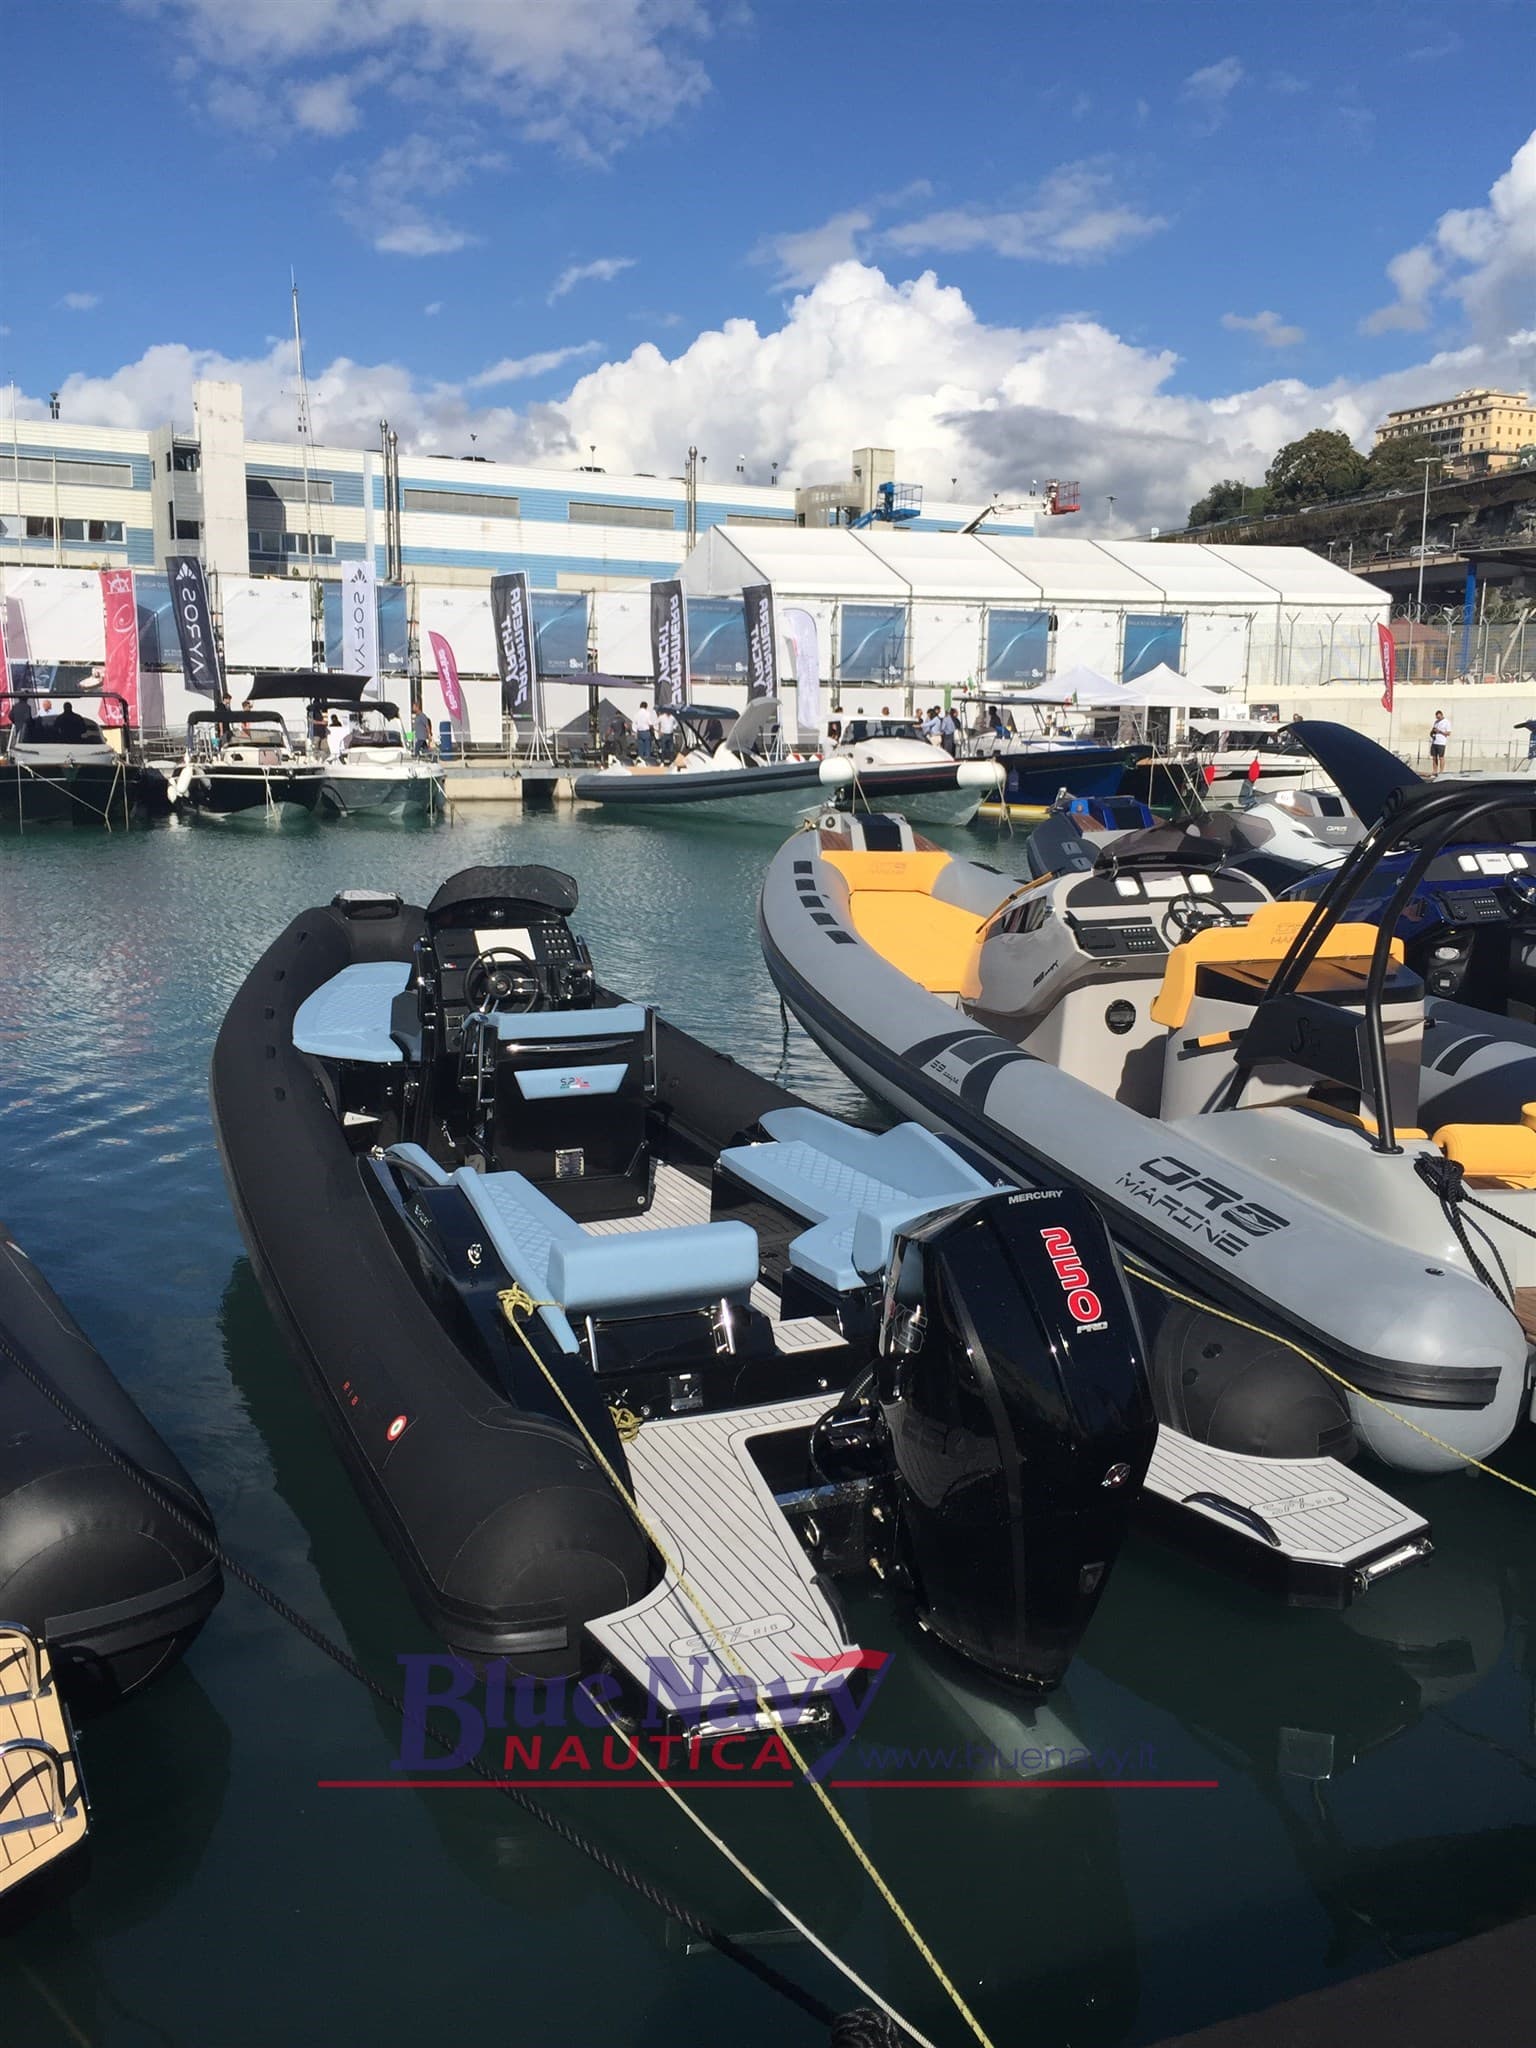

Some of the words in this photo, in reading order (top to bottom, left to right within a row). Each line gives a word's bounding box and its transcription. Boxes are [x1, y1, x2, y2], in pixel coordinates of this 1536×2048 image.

[1008, 1190, 1063, 1204] MERCURY
[1115, 1172, 1249, 1257] MARINE
[1040, 1226, 1102, 1323] 250
[1076, 1321, 1108, 1334] PRO
